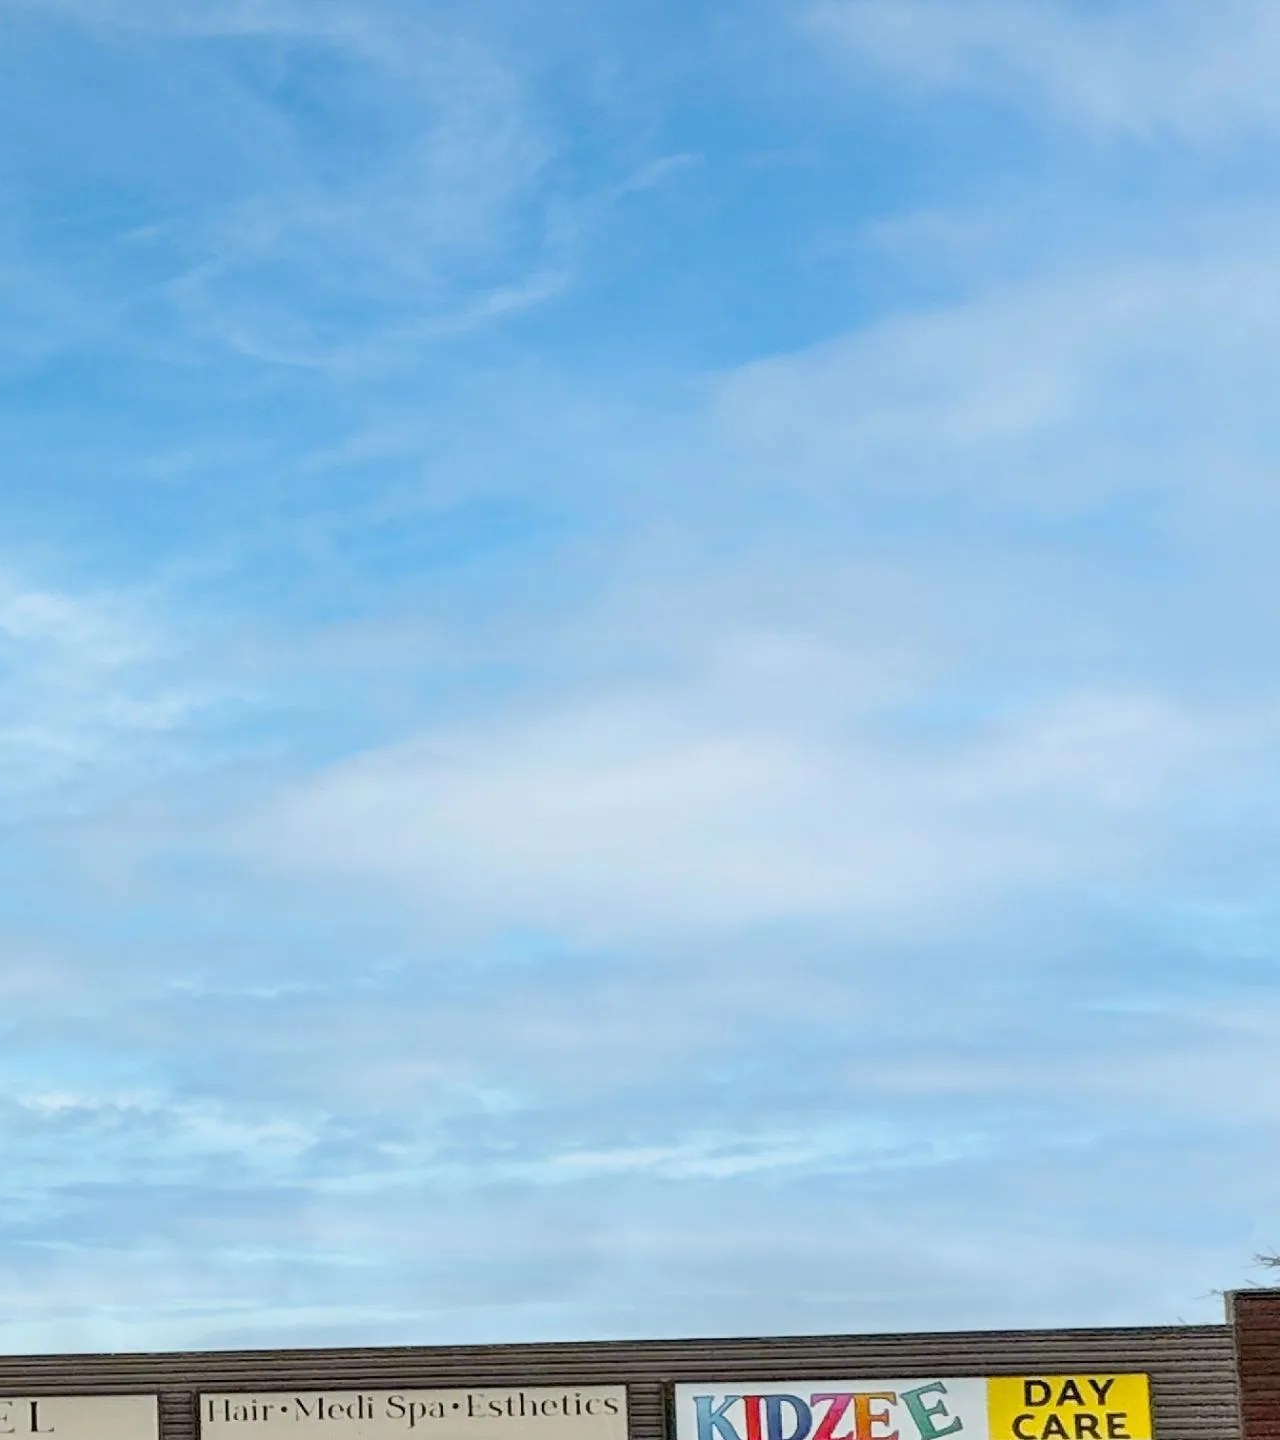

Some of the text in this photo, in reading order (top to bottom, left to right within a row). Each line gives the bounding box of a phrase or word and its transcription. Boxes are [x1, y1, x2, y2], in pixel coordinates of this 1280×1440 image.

[1023, 1378, 1115, 1407] DAY
[386, 1394, 445, 1428] Spa
[1011, 1412, 1132, 1440] CARE
